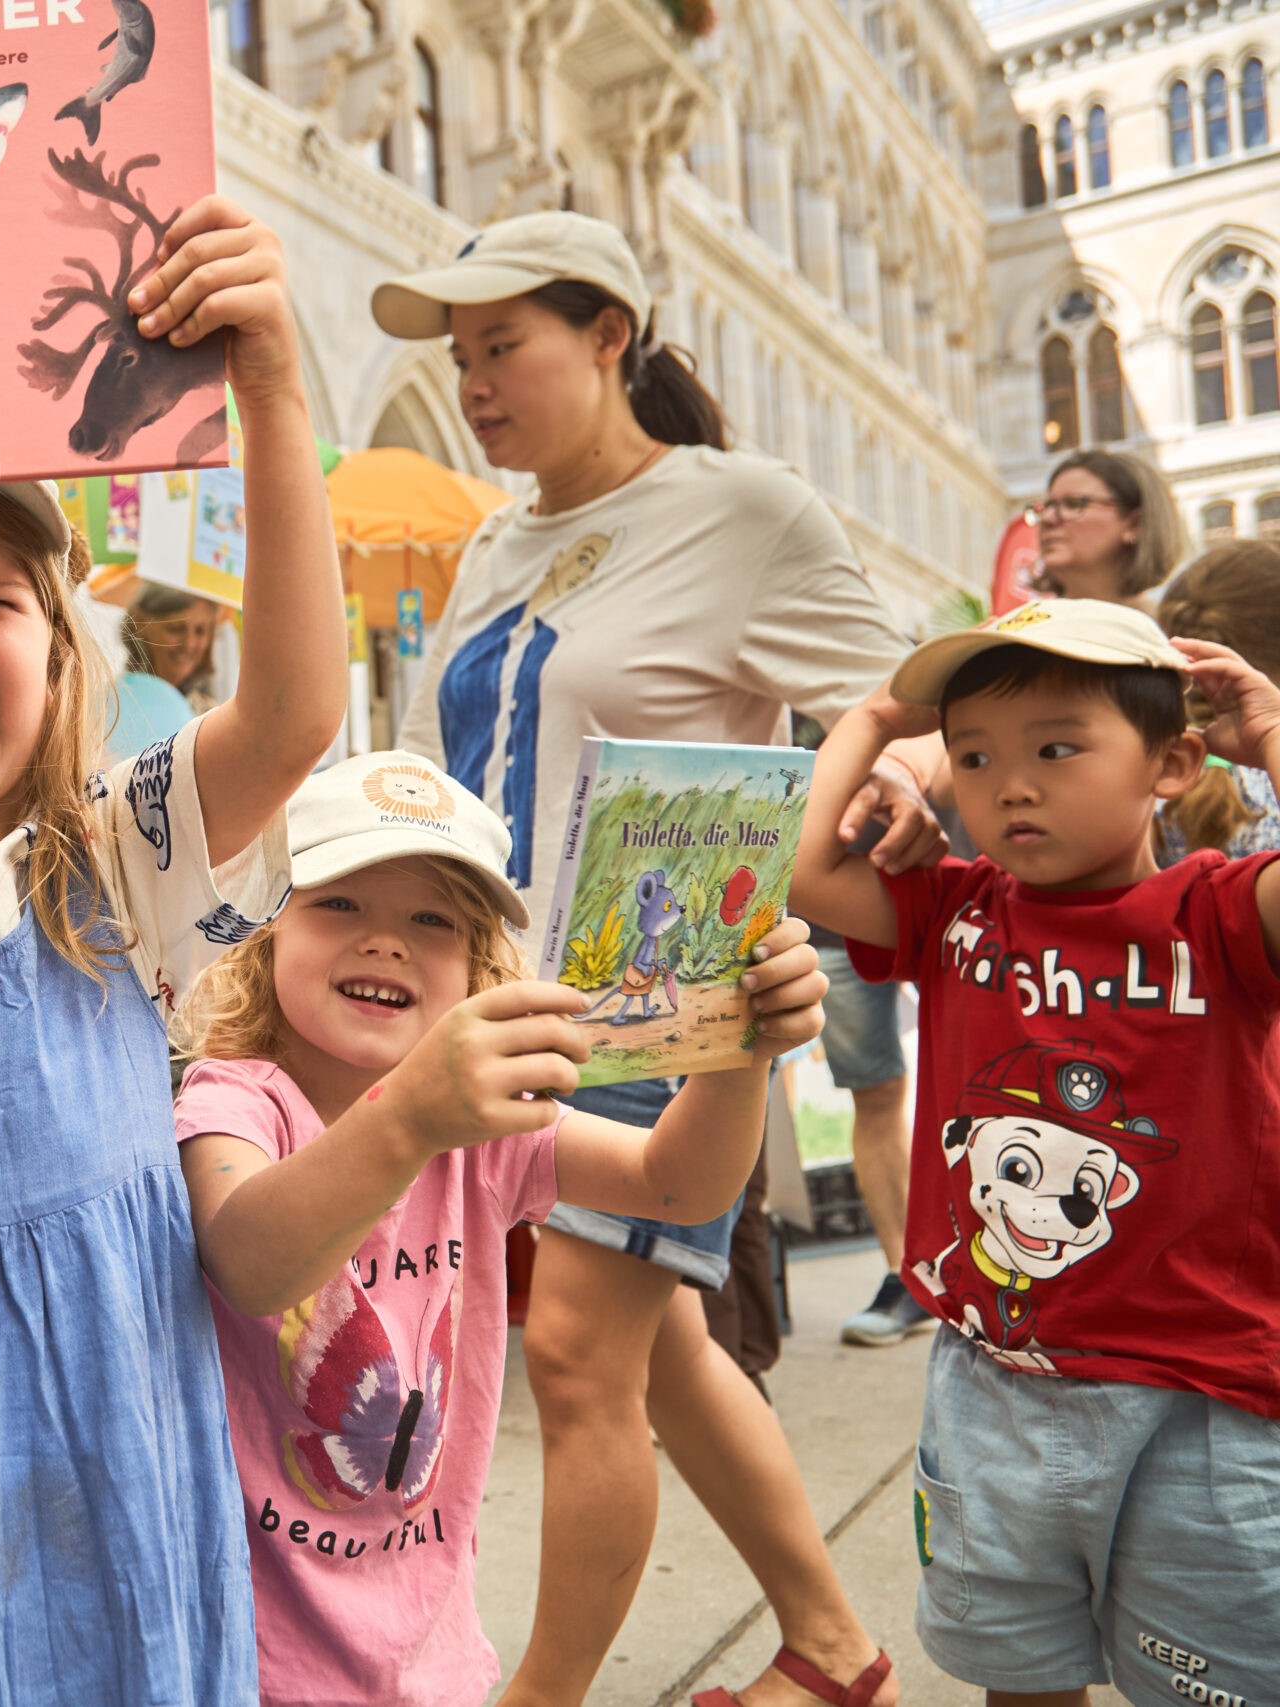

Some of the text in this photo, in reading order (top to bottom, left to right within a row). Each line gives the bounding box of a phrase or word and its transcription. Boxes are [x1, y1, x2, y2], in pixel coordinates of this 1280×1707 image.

[578, 775, 590, 802] Maus
[703, 822, 730, 847] die
[733, 821, 781, 848] Maus
[394, 1239, 463, 1281] ARE
[1137, 1631, 1210, 1677] KEEP
